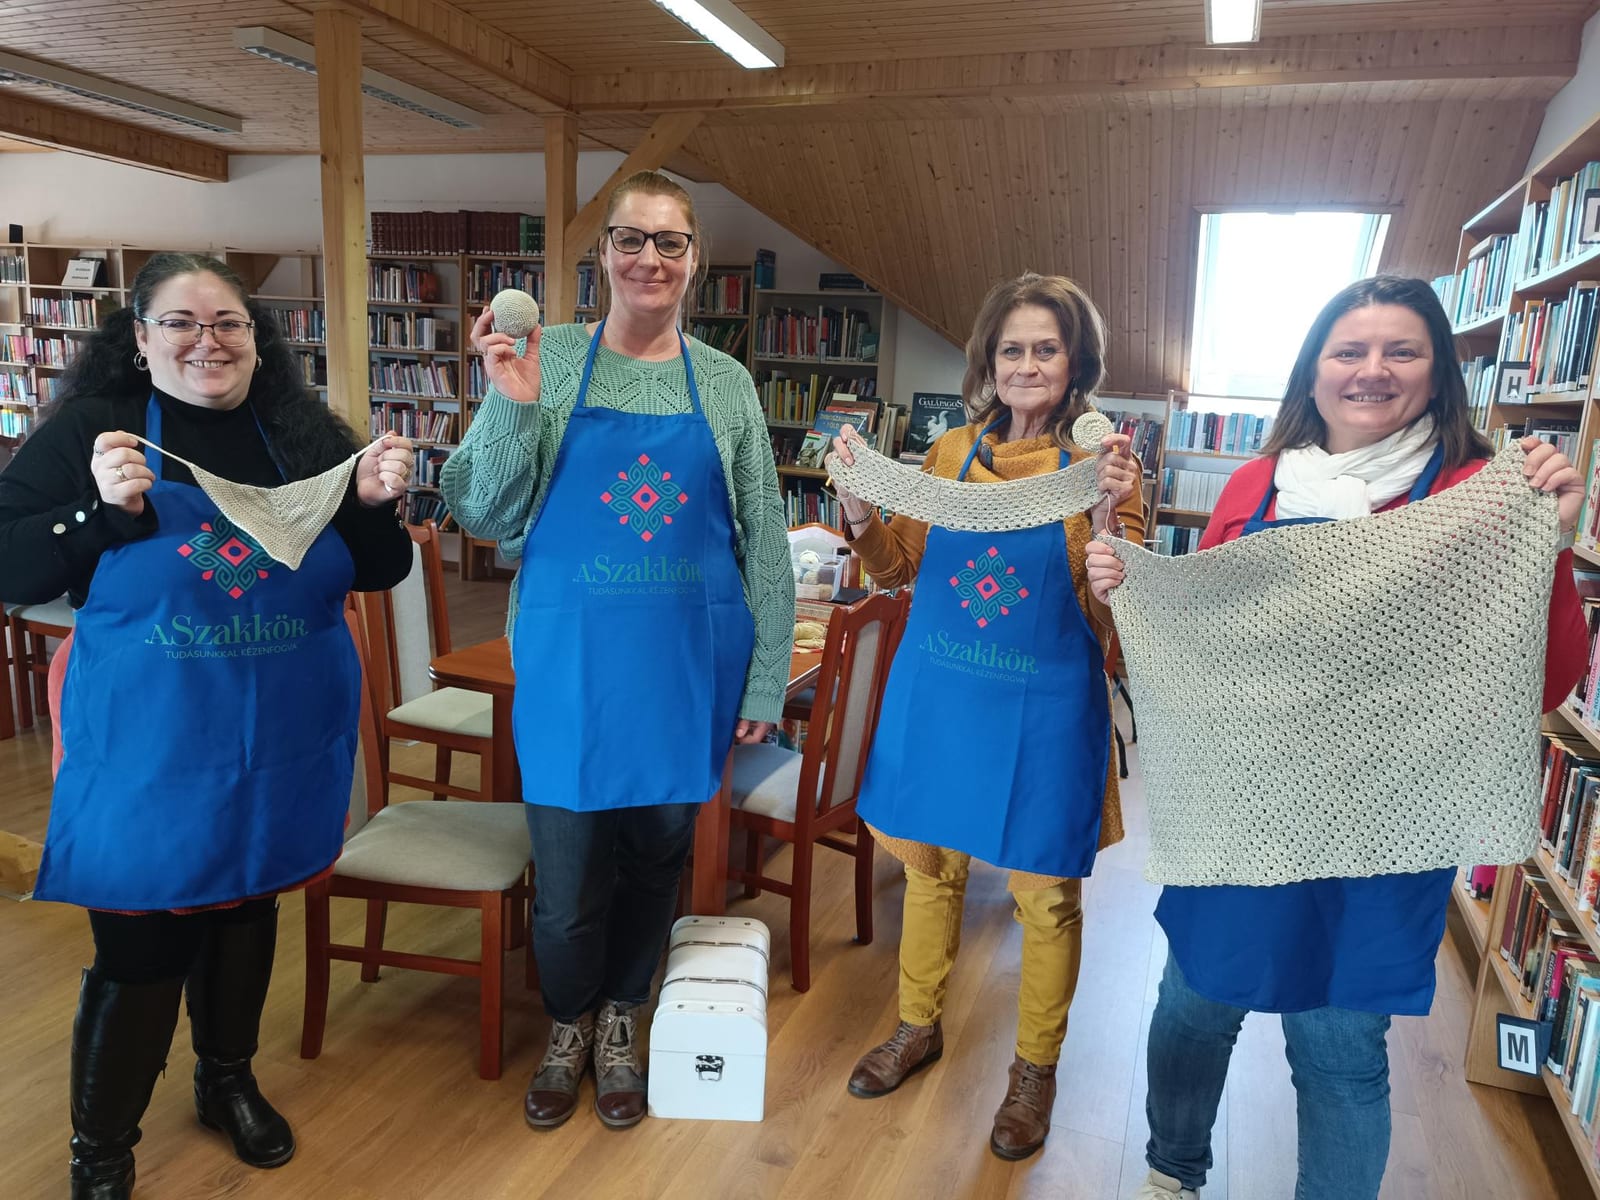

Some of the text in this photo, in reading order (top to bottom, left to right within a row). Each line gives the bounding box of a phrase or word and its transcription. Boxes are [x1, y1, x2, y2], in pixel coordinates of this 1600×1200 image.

[1507, 376, 1522, 396] H
[165, 643, 297, 659] TUDÁSUNKKAL KÉZENFOGVA
[1507, 1031, 1530, 1064] M
